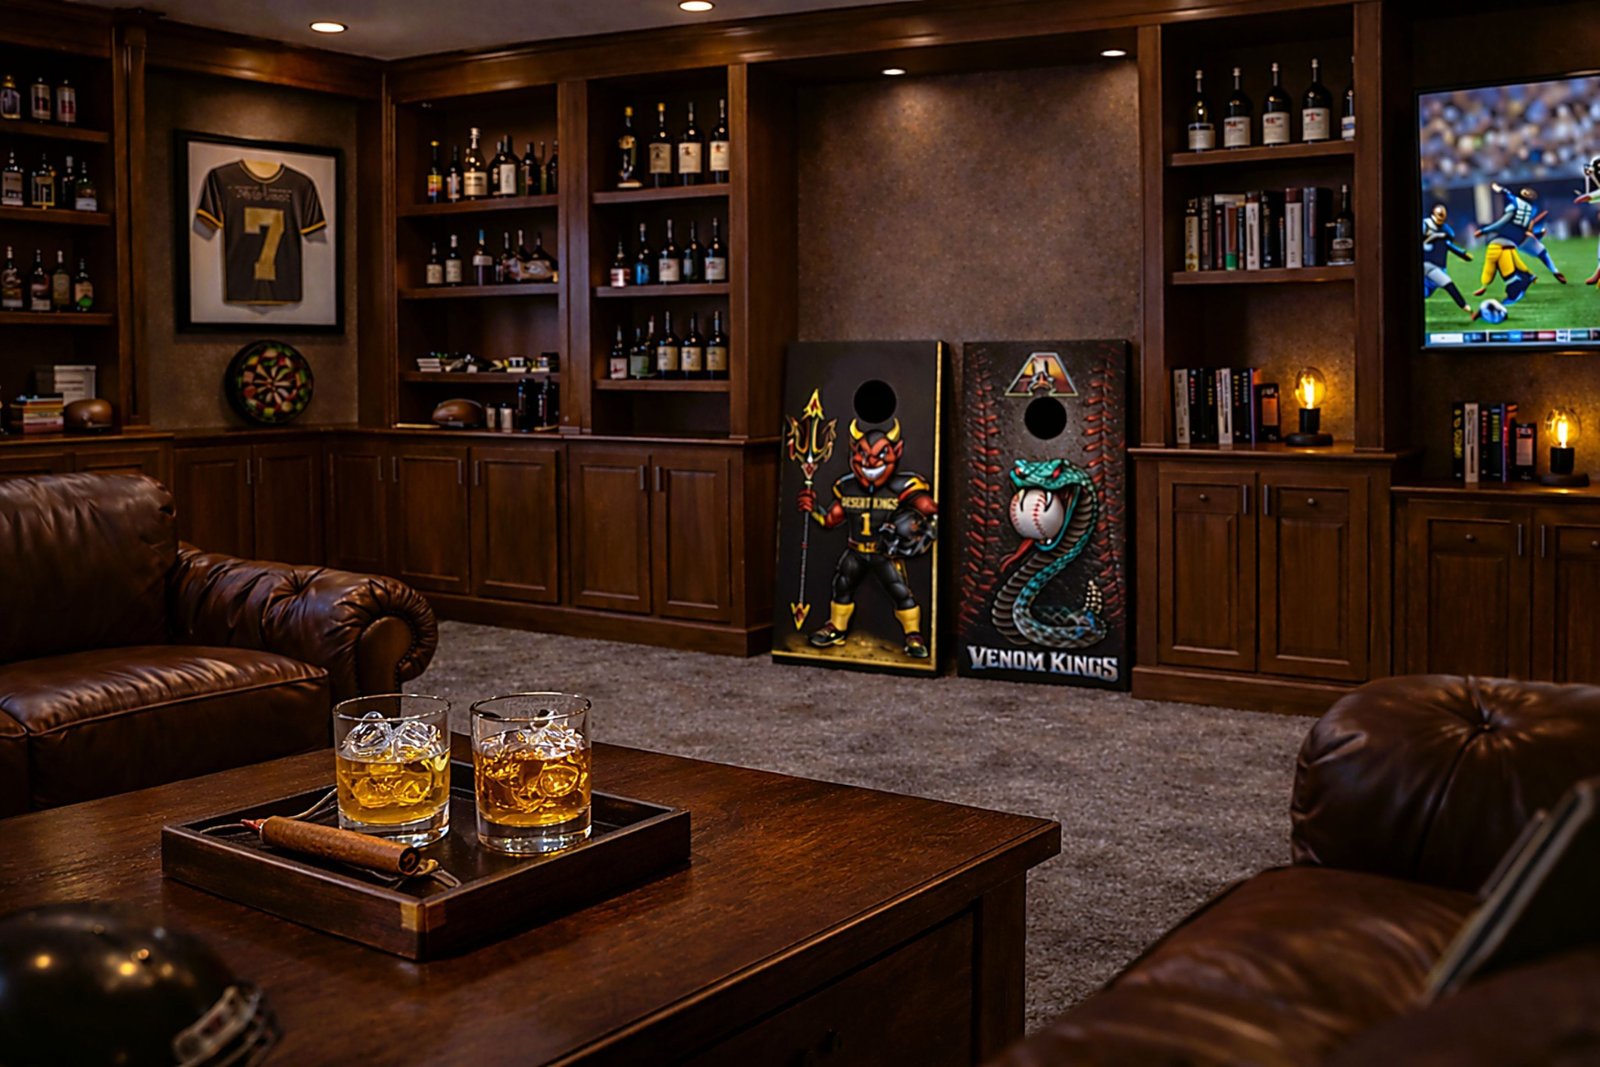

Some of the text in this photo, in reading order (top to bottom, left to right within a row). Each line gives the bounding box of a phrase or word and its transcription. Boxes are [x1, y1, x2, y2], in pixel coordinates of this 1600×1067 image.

[244, 207, 285, 280] 7
[860, 512, 872, 536] 1
[967, 646, 1118, 682] VENOM KINGS
